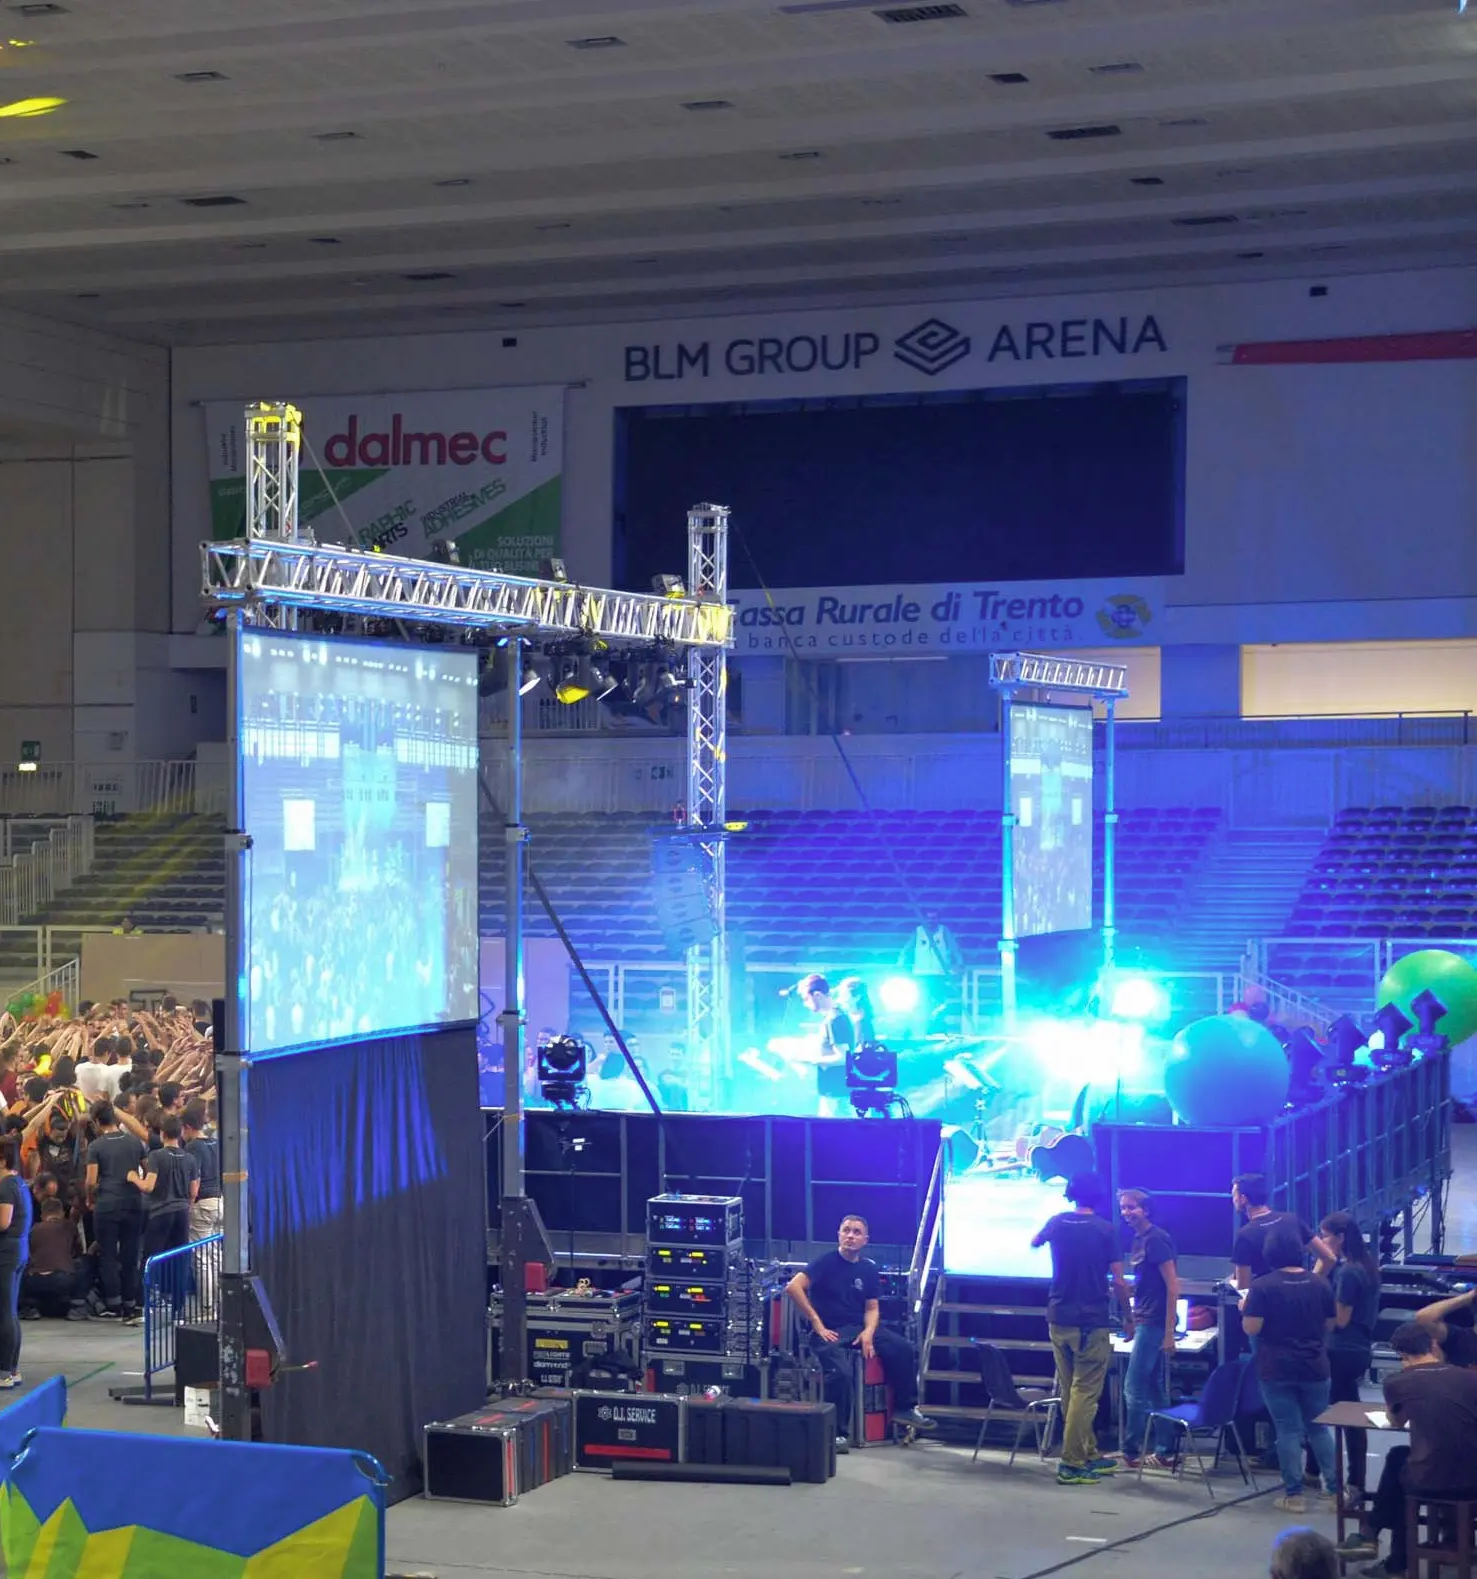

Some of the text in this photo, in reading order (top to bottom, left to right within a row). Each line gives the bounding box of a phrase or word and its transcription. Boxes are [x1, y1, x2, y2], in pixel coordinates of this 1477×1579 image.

[625, 314, 1169, 382] BLM GROUP ARENA
[324, 413, 508, 467] dalmec
[424, 477, 506, 539] ADHESIVES
[816, 593, 922, 625] Rurale
[931, 591, 962, 622] di
[973, 590, 1084, 620] Trento
[748, 633, 817, 649] banca
[828, 628, 930, 647] custode
[939, 626, 1001, 644] della
[627, 1407, 656, 1424] SERVICE
